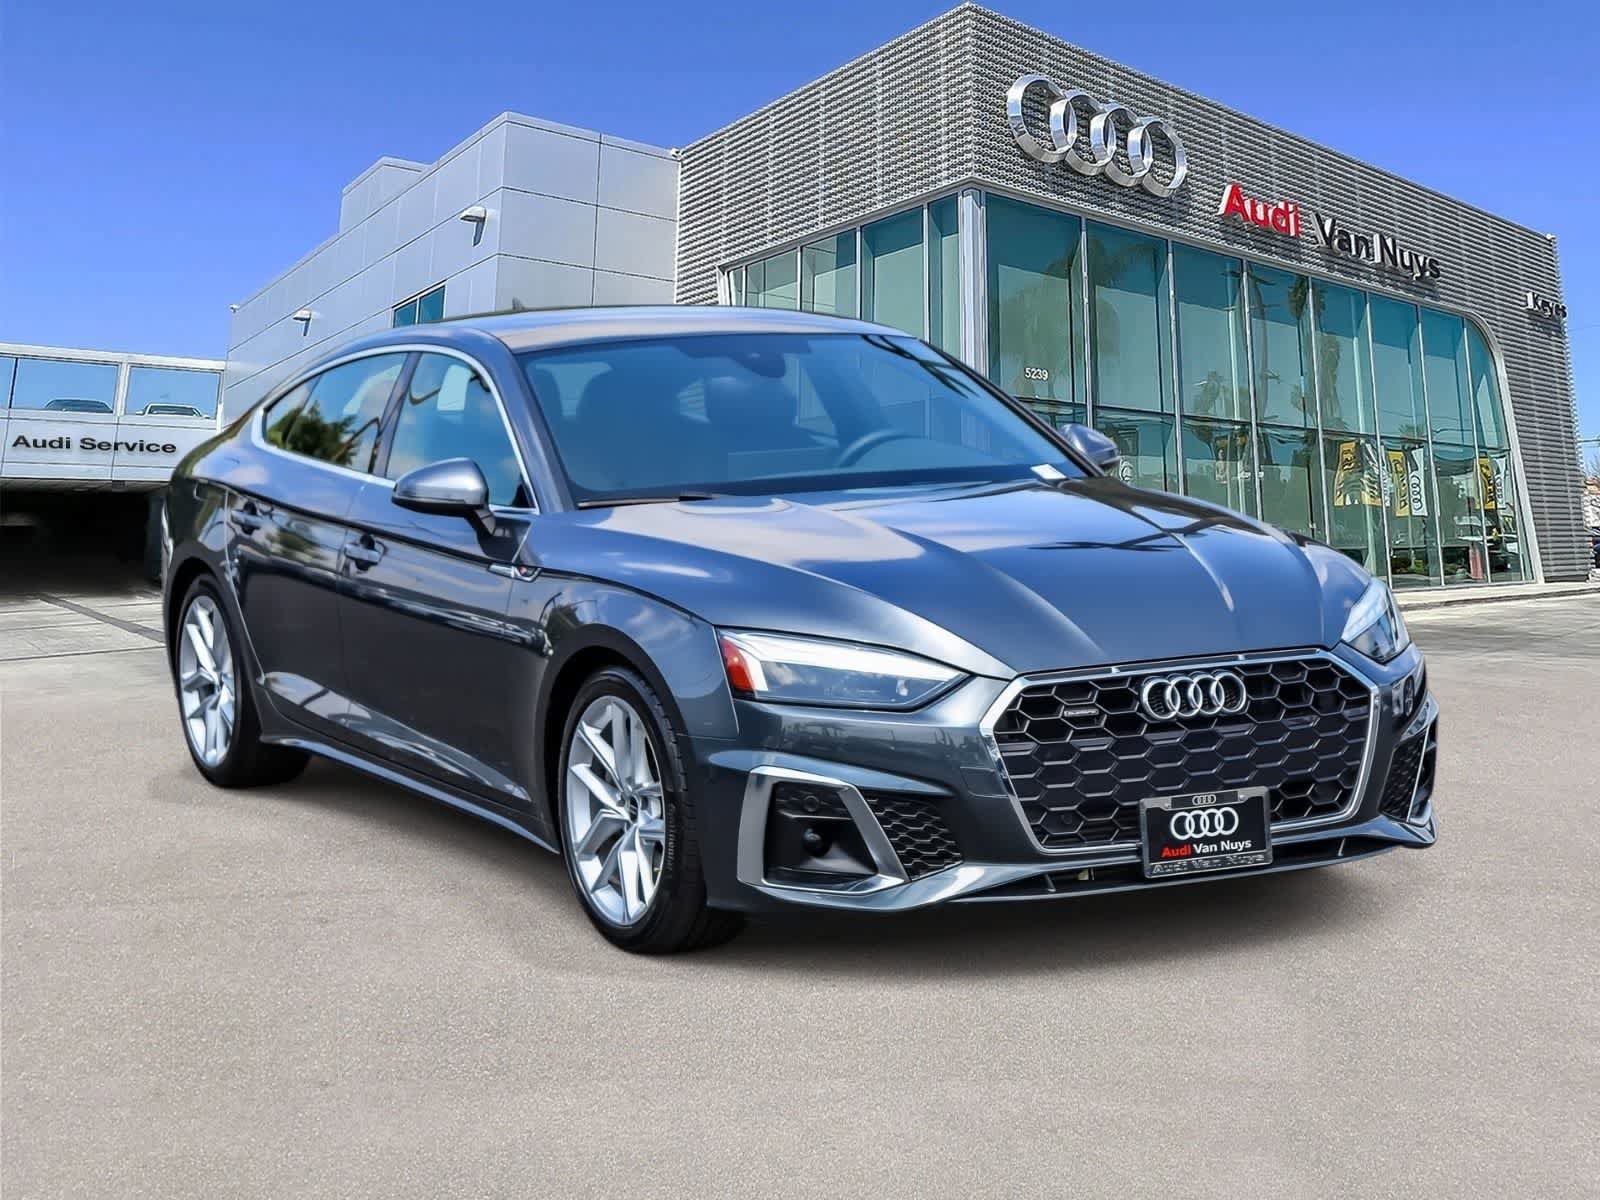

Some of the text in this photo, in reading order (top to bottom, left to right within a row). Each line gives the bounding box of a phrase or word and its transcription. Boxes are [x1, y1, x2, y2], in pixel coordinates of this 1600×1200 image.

[1218, 182, 1441, 280] Audi Van Nuys
[1024, 367, 1049, 381] 5239
[12, 434, 177, 454] Audi Service
[1161, 840, 1252, 858] Audi Van Nuys
